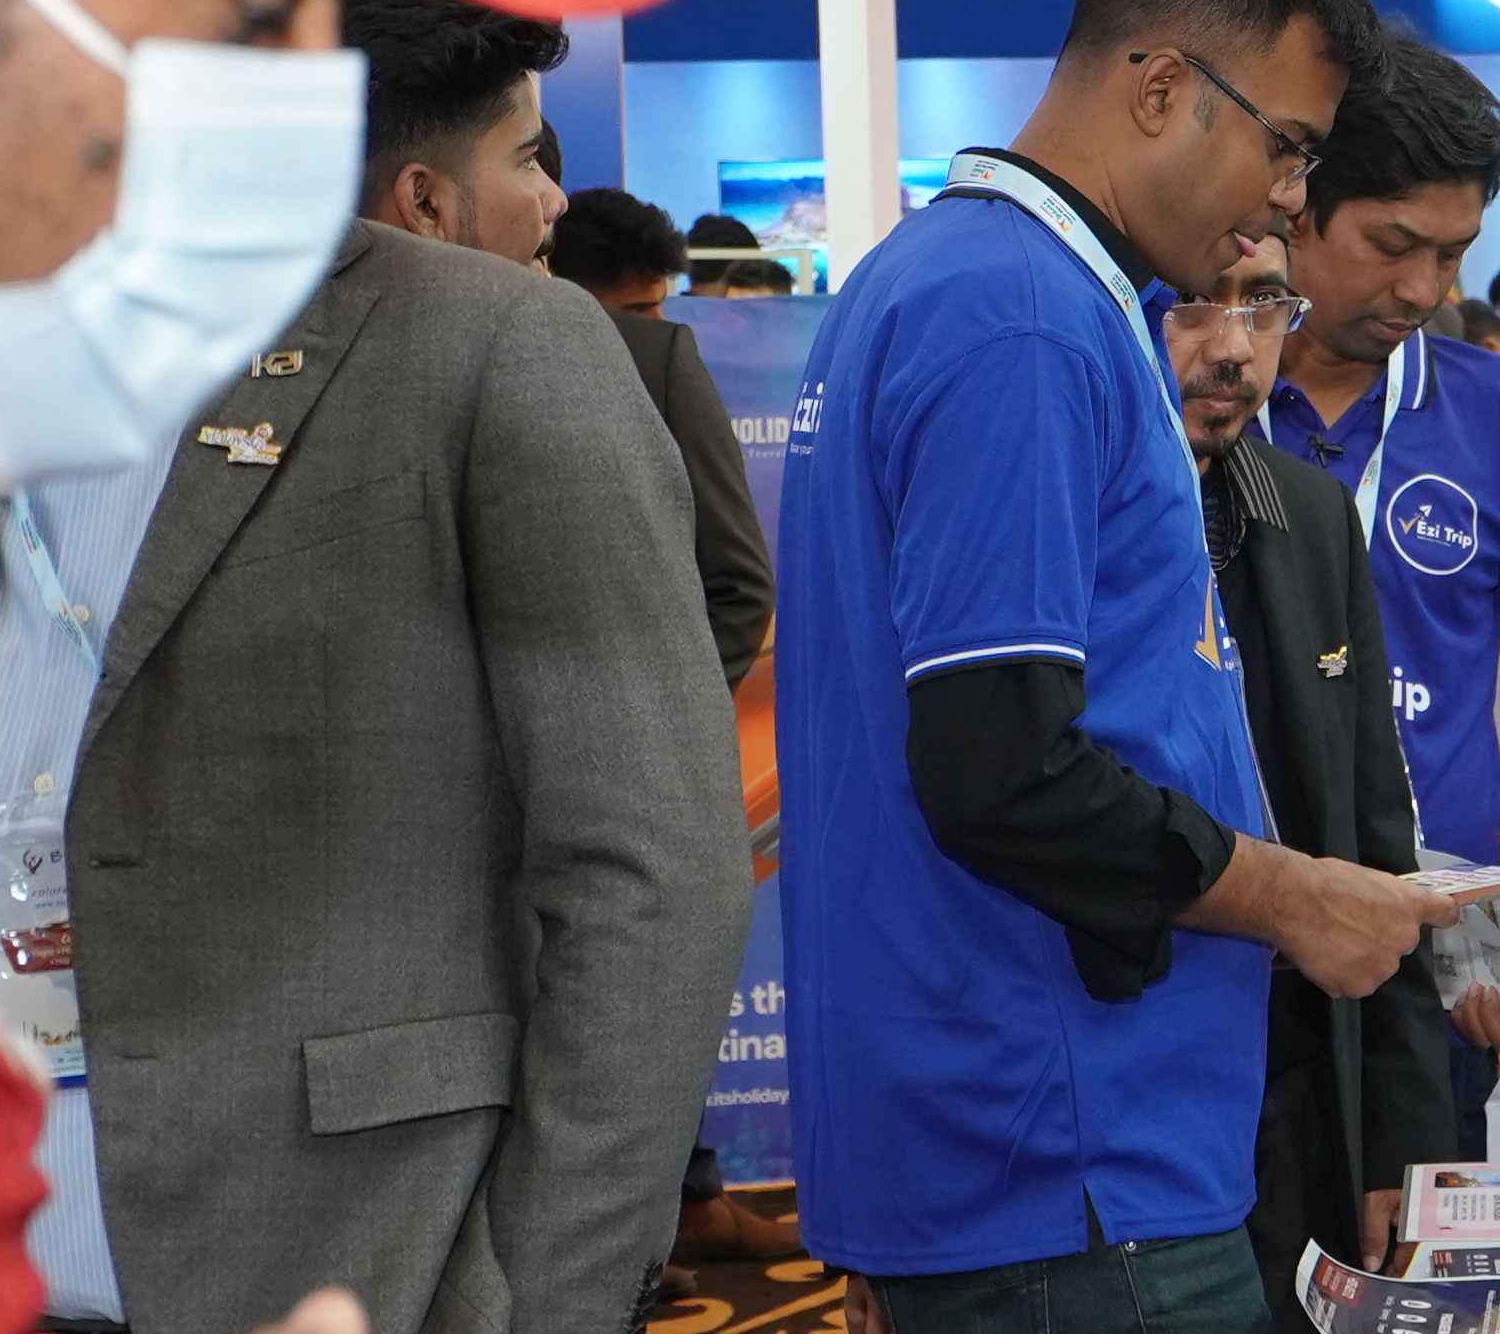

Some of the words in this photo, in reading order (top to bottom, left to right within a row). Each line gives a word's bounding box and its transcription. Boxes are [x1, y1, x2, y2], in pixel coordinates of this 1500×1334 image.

[1416, 519, 1440, 540] Ezi
[1444, 526, 1473, 550] Trip
[1388, 666, 1432, 722] ip
